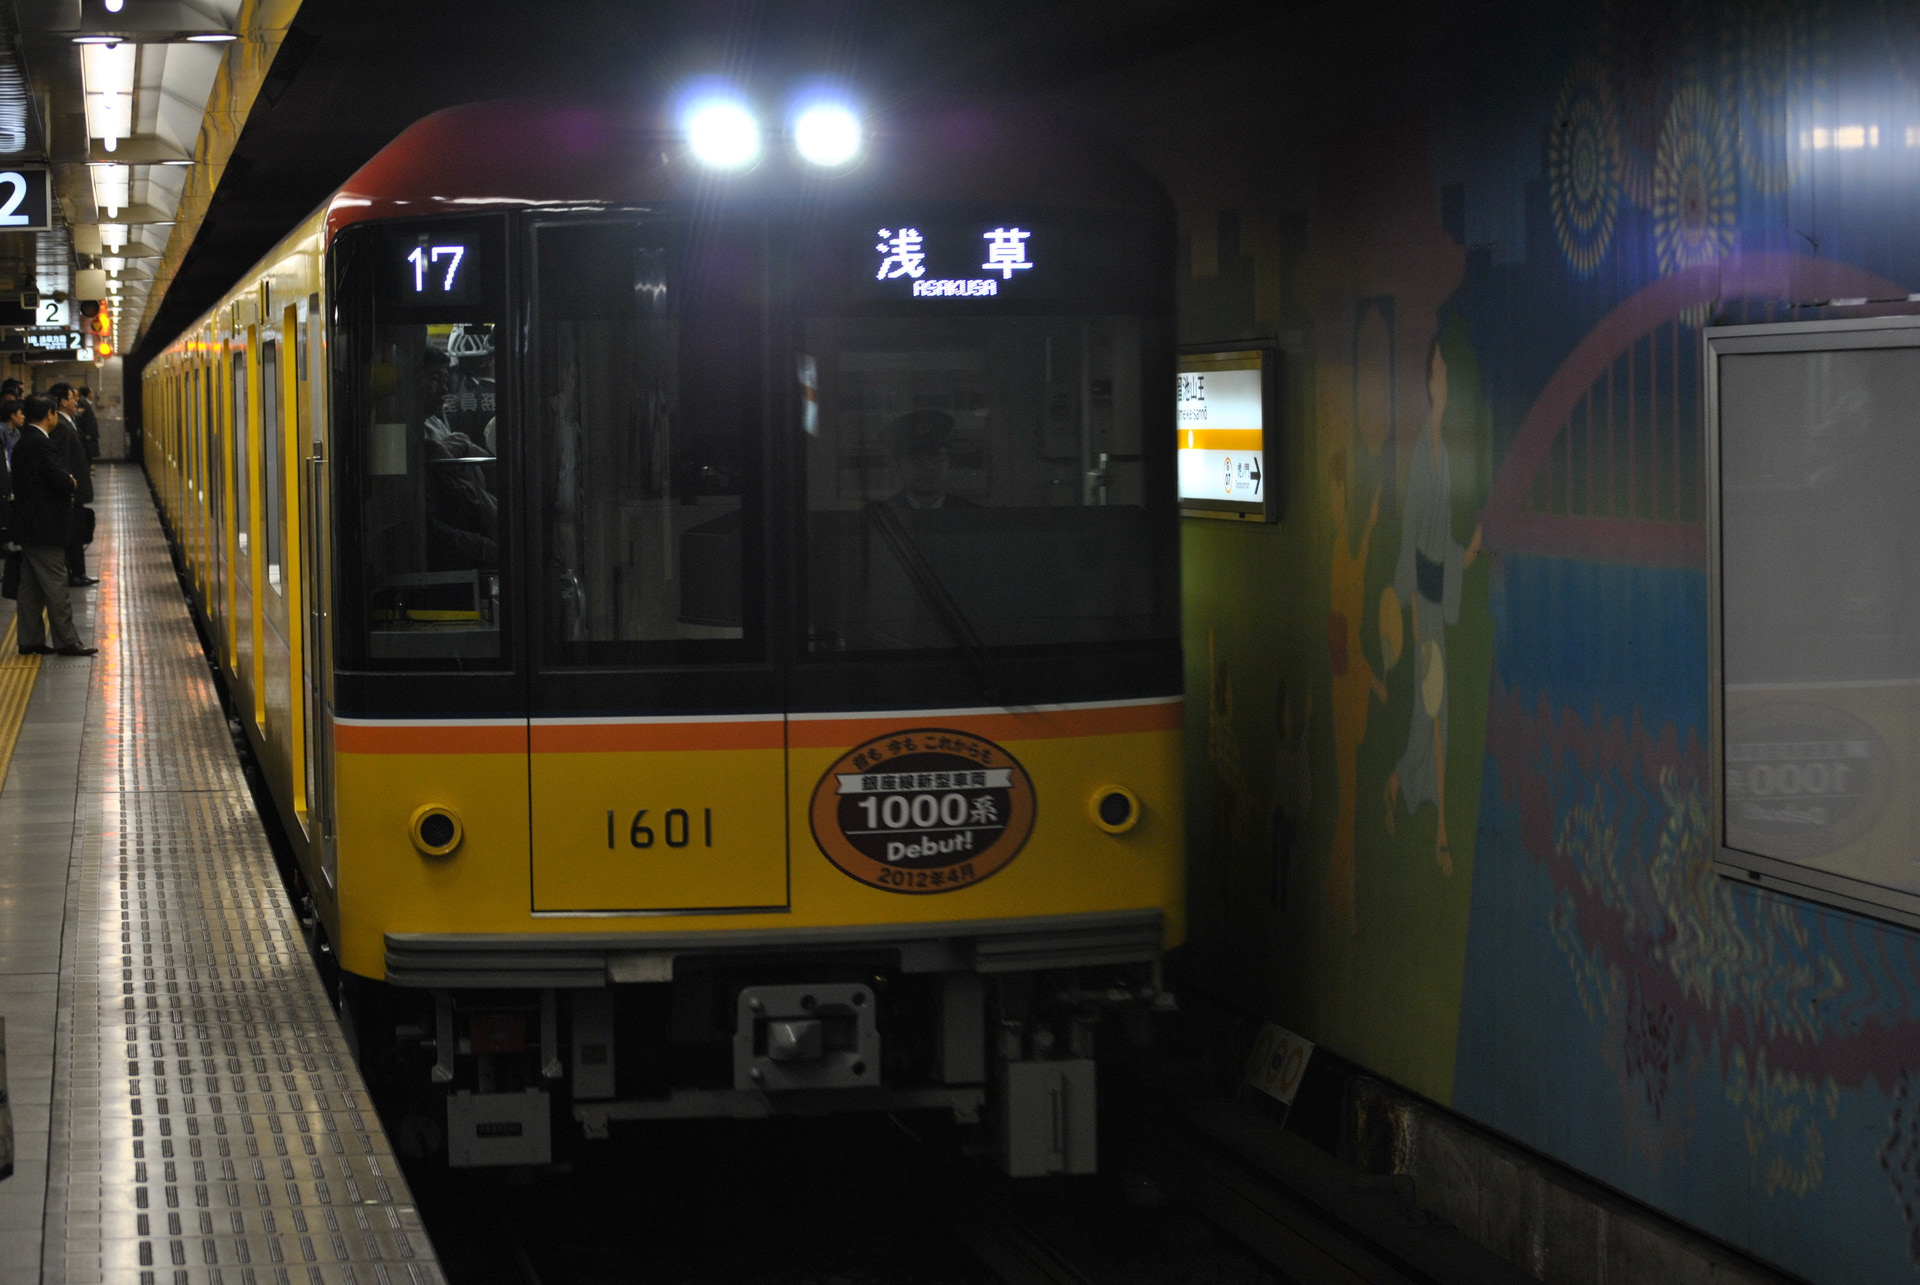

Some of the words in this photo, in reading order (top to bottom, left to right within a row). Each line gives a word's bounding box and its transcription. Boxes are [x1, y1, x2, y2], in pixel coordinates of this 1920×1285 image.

[0, 171, 29, 226] 2
[407, 246, 465, 292] 17
[876, 228, 1034, 280] 浅草
[913, 280, 998, 297] ASAKUSA
[45, 303, 60, 323] 2
[69, 332, 82, 350] 2
[858, 793, 998, 829] 1000系
[606, 807, 712, 850] 1601
[886, 830, 974, 862] Debut!
[877, 863, 976, 888] 2012年4月
